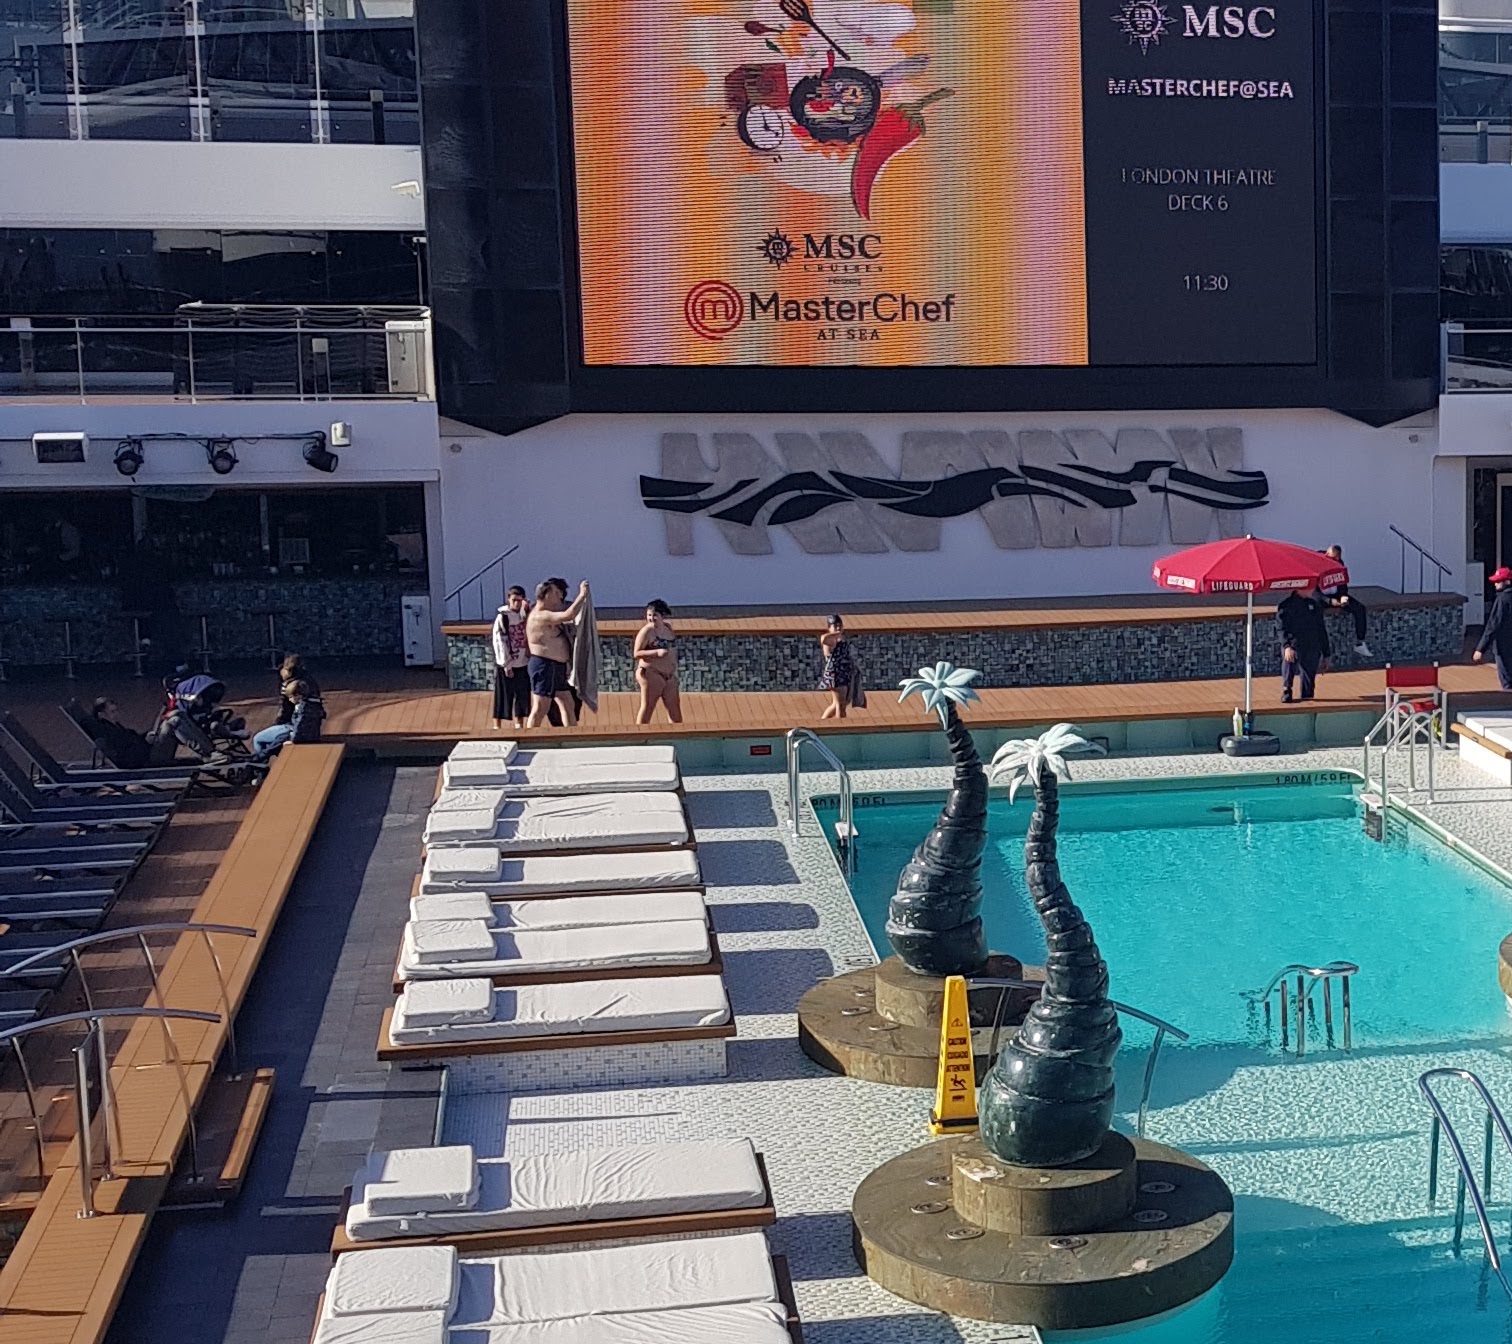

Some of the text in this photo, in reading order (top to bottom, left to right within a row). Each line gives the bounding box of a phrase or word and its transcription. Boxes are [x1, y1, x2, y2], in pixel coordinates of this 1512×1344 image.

[1182, 5, 1276, 38] MSC
[1108, 77, 1294, 99] MASTERCHEF@SEA
[1121, 168, 1199, 185] LONDON
[1168, 194, 1229, 211] DECK 6
[803, 233, 882, 260] MSC
[1183, 274, 1229, 291] 11:30
[749, 291, 956, 322] MasterChef
[817, 328, 880, 341] AT SEA
[1211, 581, 1254, 591] LIFEGUARD
